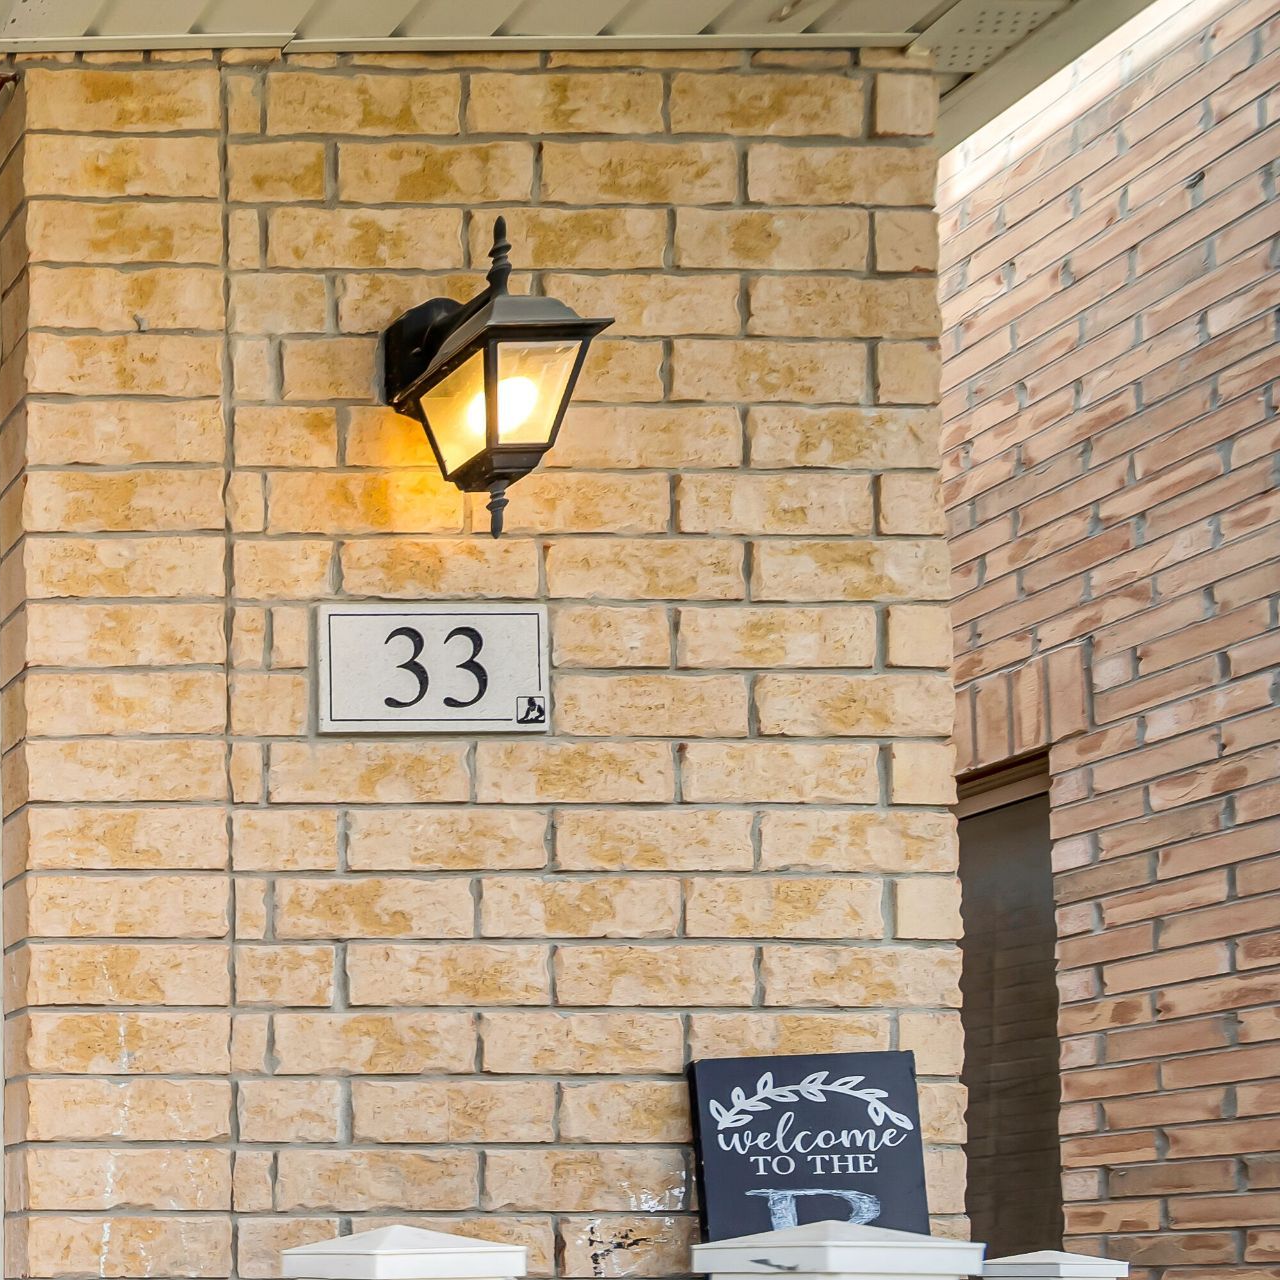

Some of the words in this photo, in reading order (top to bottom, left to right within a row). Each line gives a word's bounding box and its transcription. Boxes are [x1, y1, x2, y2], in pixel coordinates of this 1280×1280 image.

[384, 626, 488, 709] 33
[717, 1111, 908, 1155] welcome
[749, 1155, 796, 1175] TO
[807, 1154, 879, 1174] THE
